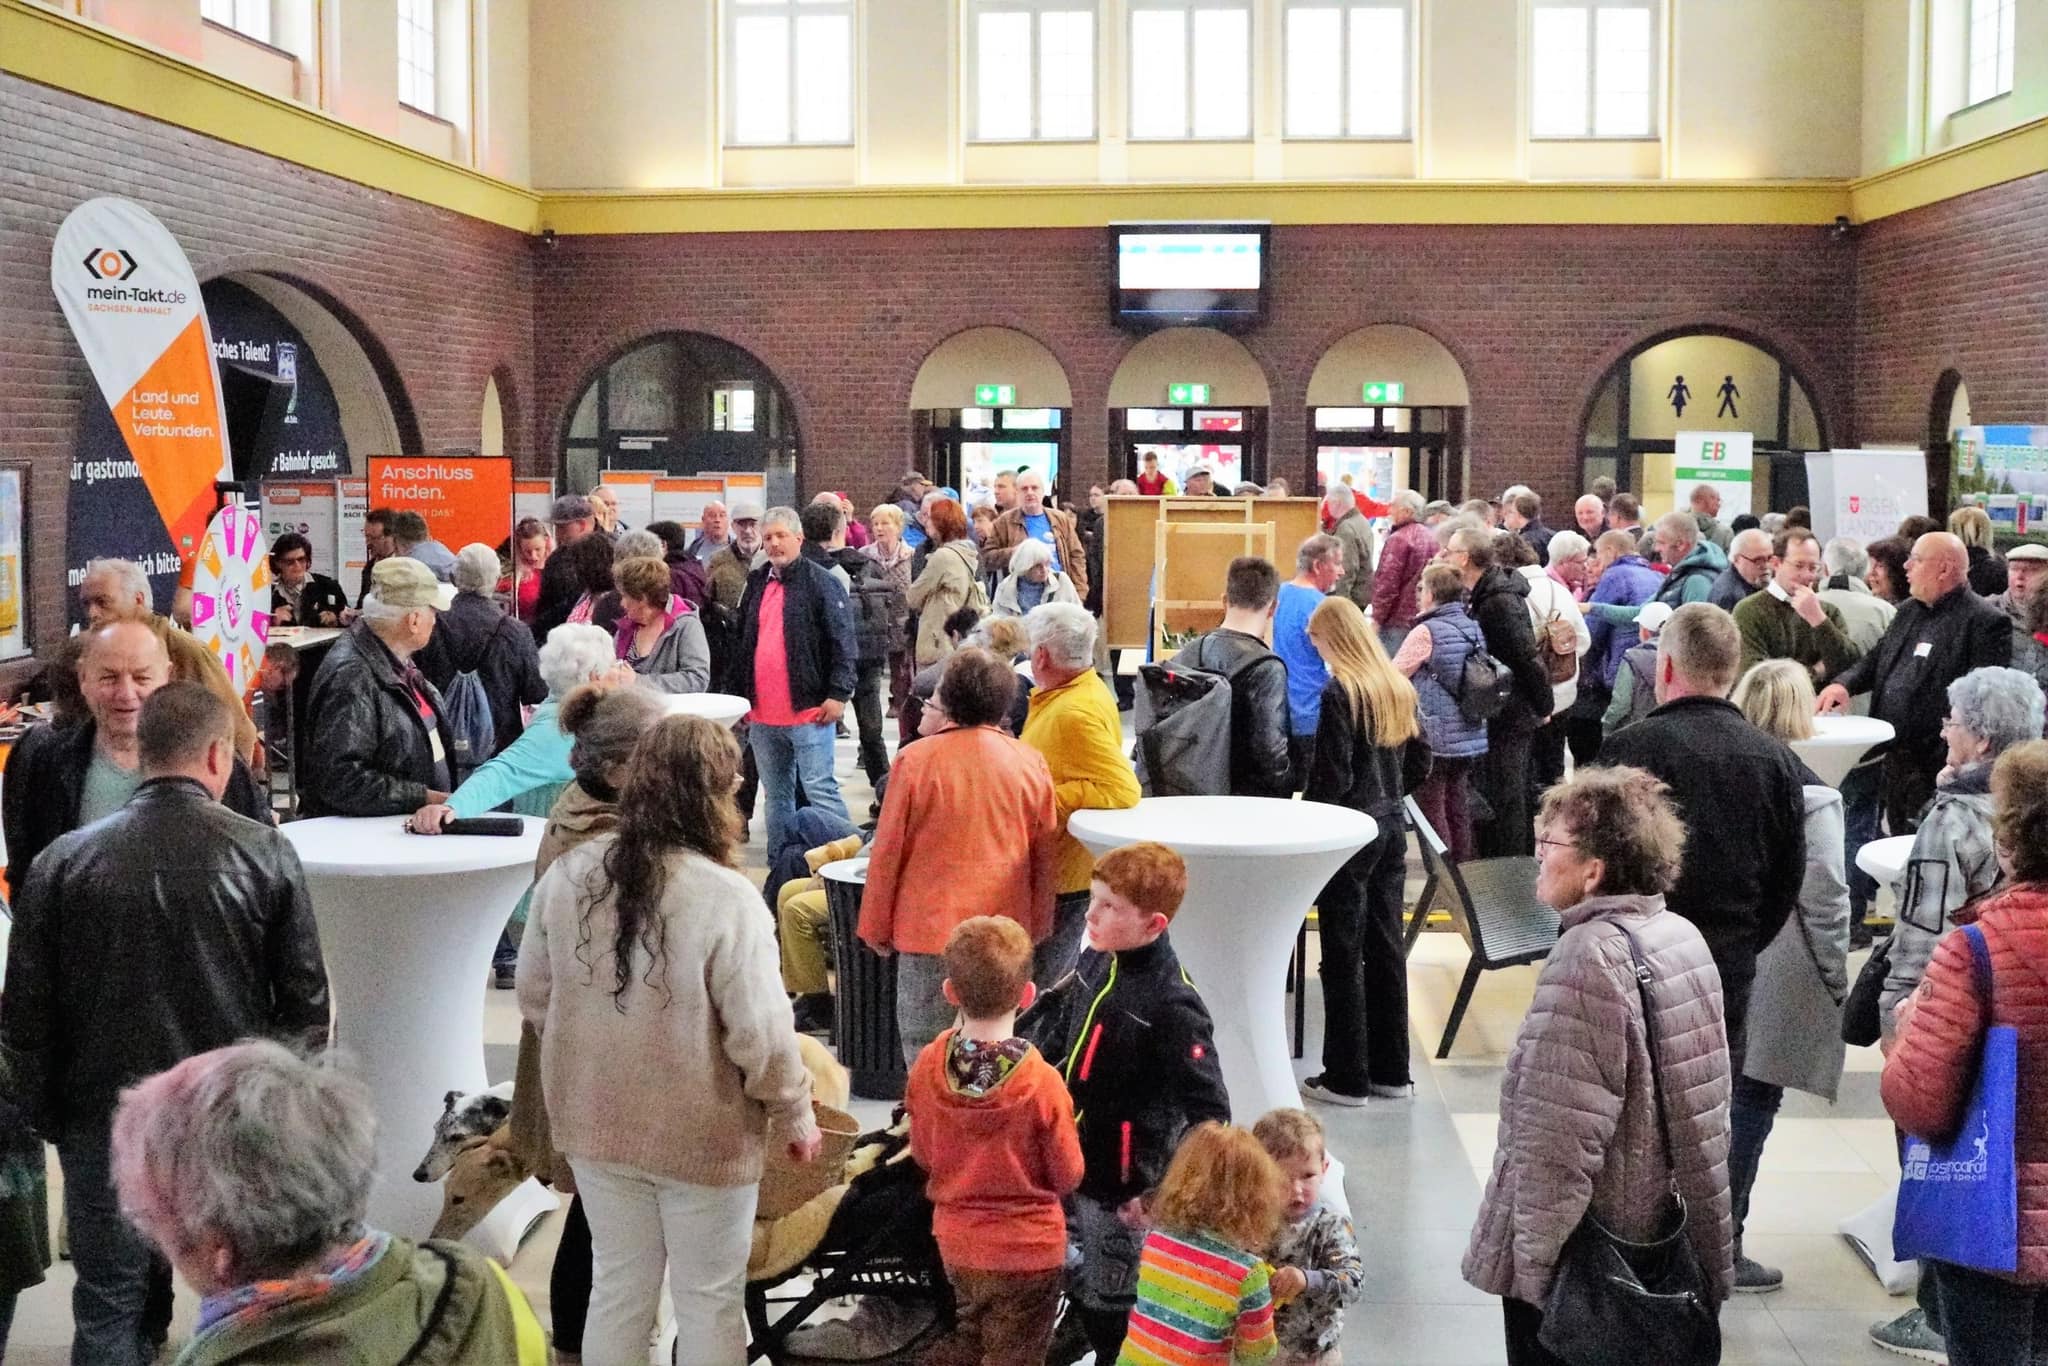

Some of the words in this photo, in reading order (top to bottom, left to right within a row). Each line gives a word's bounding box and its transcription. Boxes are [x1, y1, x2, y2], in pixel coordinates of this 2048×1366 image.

[87, 286, 187, 304] mein-Takt.de
[238, 340, 271, 362] Talent?
[132, 390, 168, 404] Land
[171, 392, 200, 405] und
[132, 406, 176, 421] Leute.
[132, 423, 215, 438] Verbunden.
[279, 450, 310, 471] Bahnhof
[310, 449, 338, 474] gesucht.
[86, 457, 143, 485] gastrono
[381, 464, 474, 480] Anschluss
[381, 483, 446, 500] finden.
[156, 551, 182, 575] bitte
